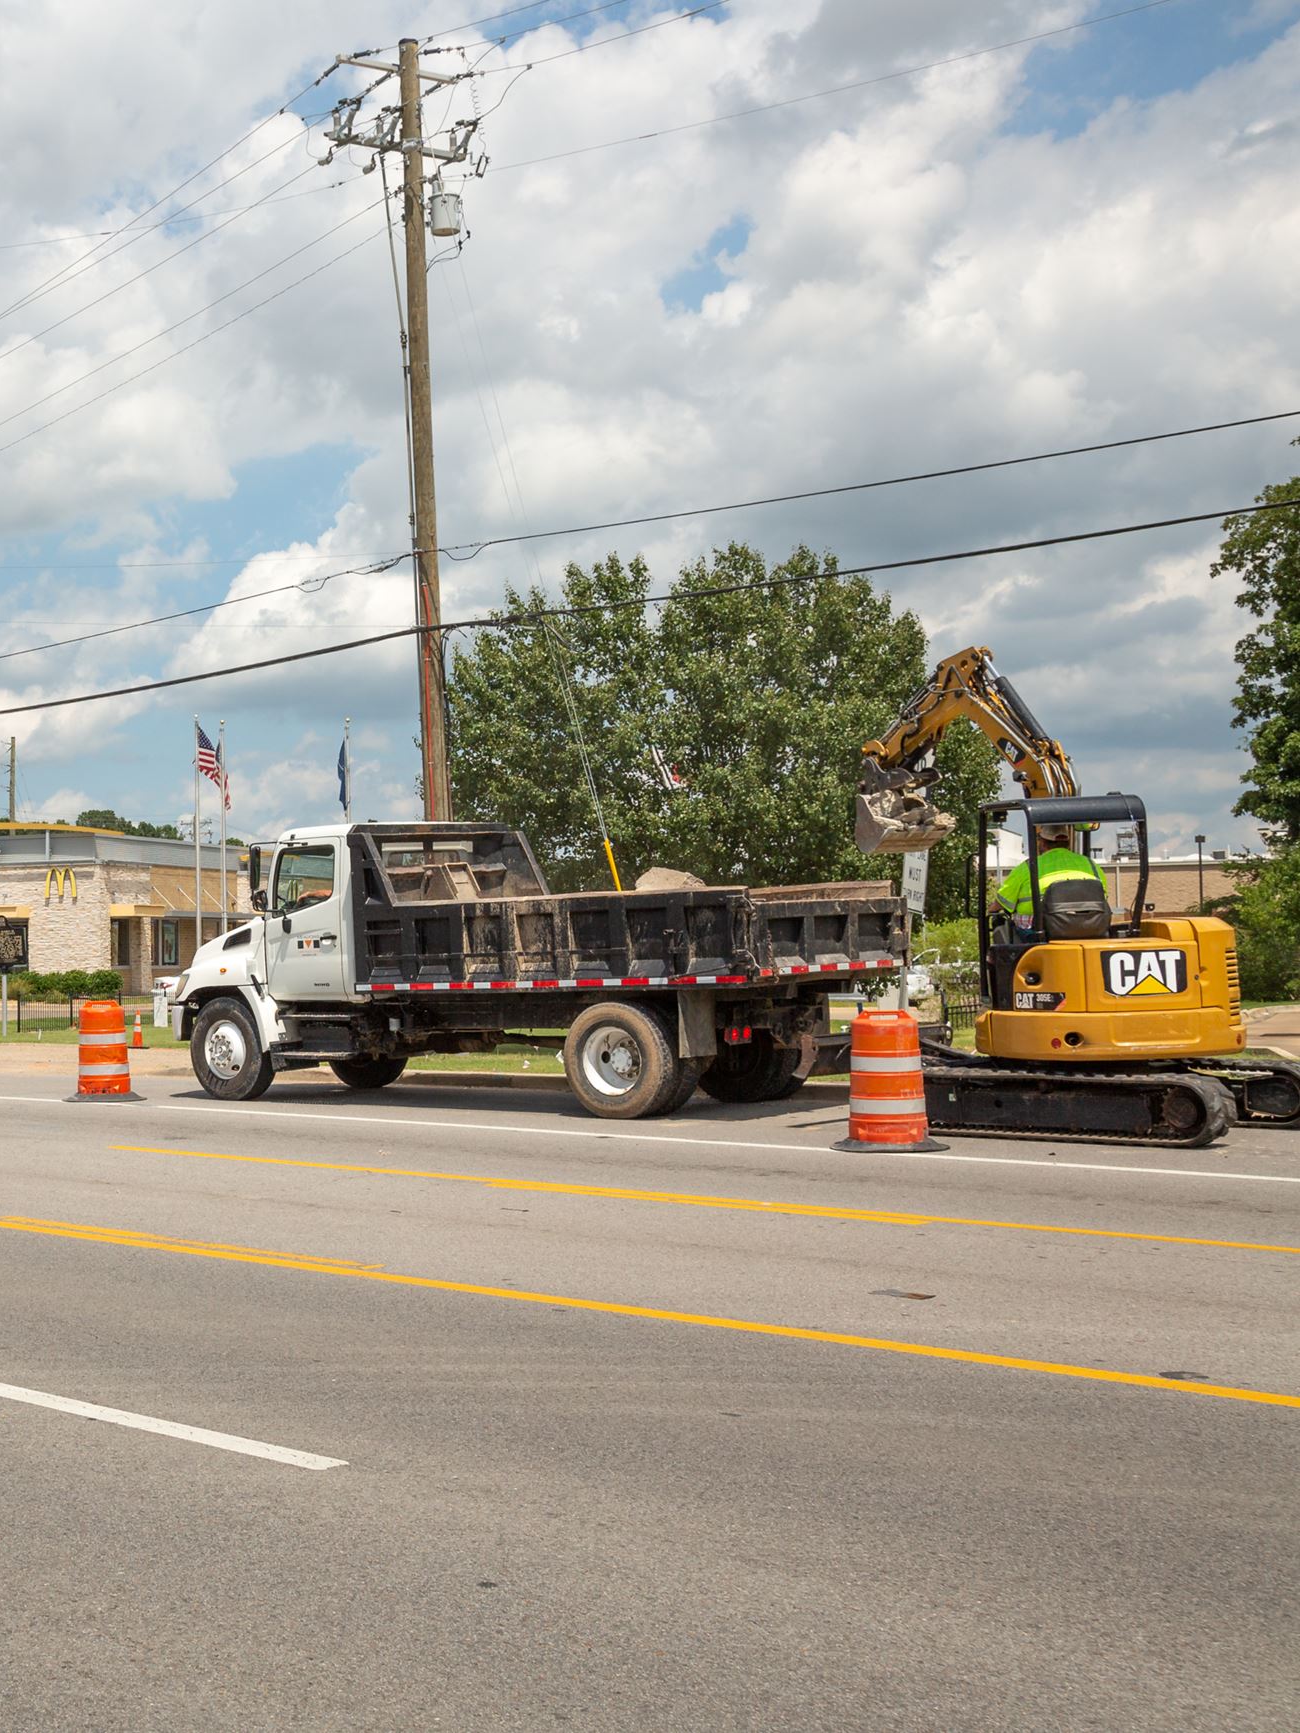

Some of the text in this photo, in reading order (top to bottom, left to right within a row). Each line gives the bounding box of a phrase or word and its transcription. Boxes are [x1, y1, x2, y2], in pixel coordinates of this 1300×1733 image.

[908, 866, 922, 881] MUST
[1109, 951, 1181, 996] CAT
[1015, 992, 1034, 1009] CAT
